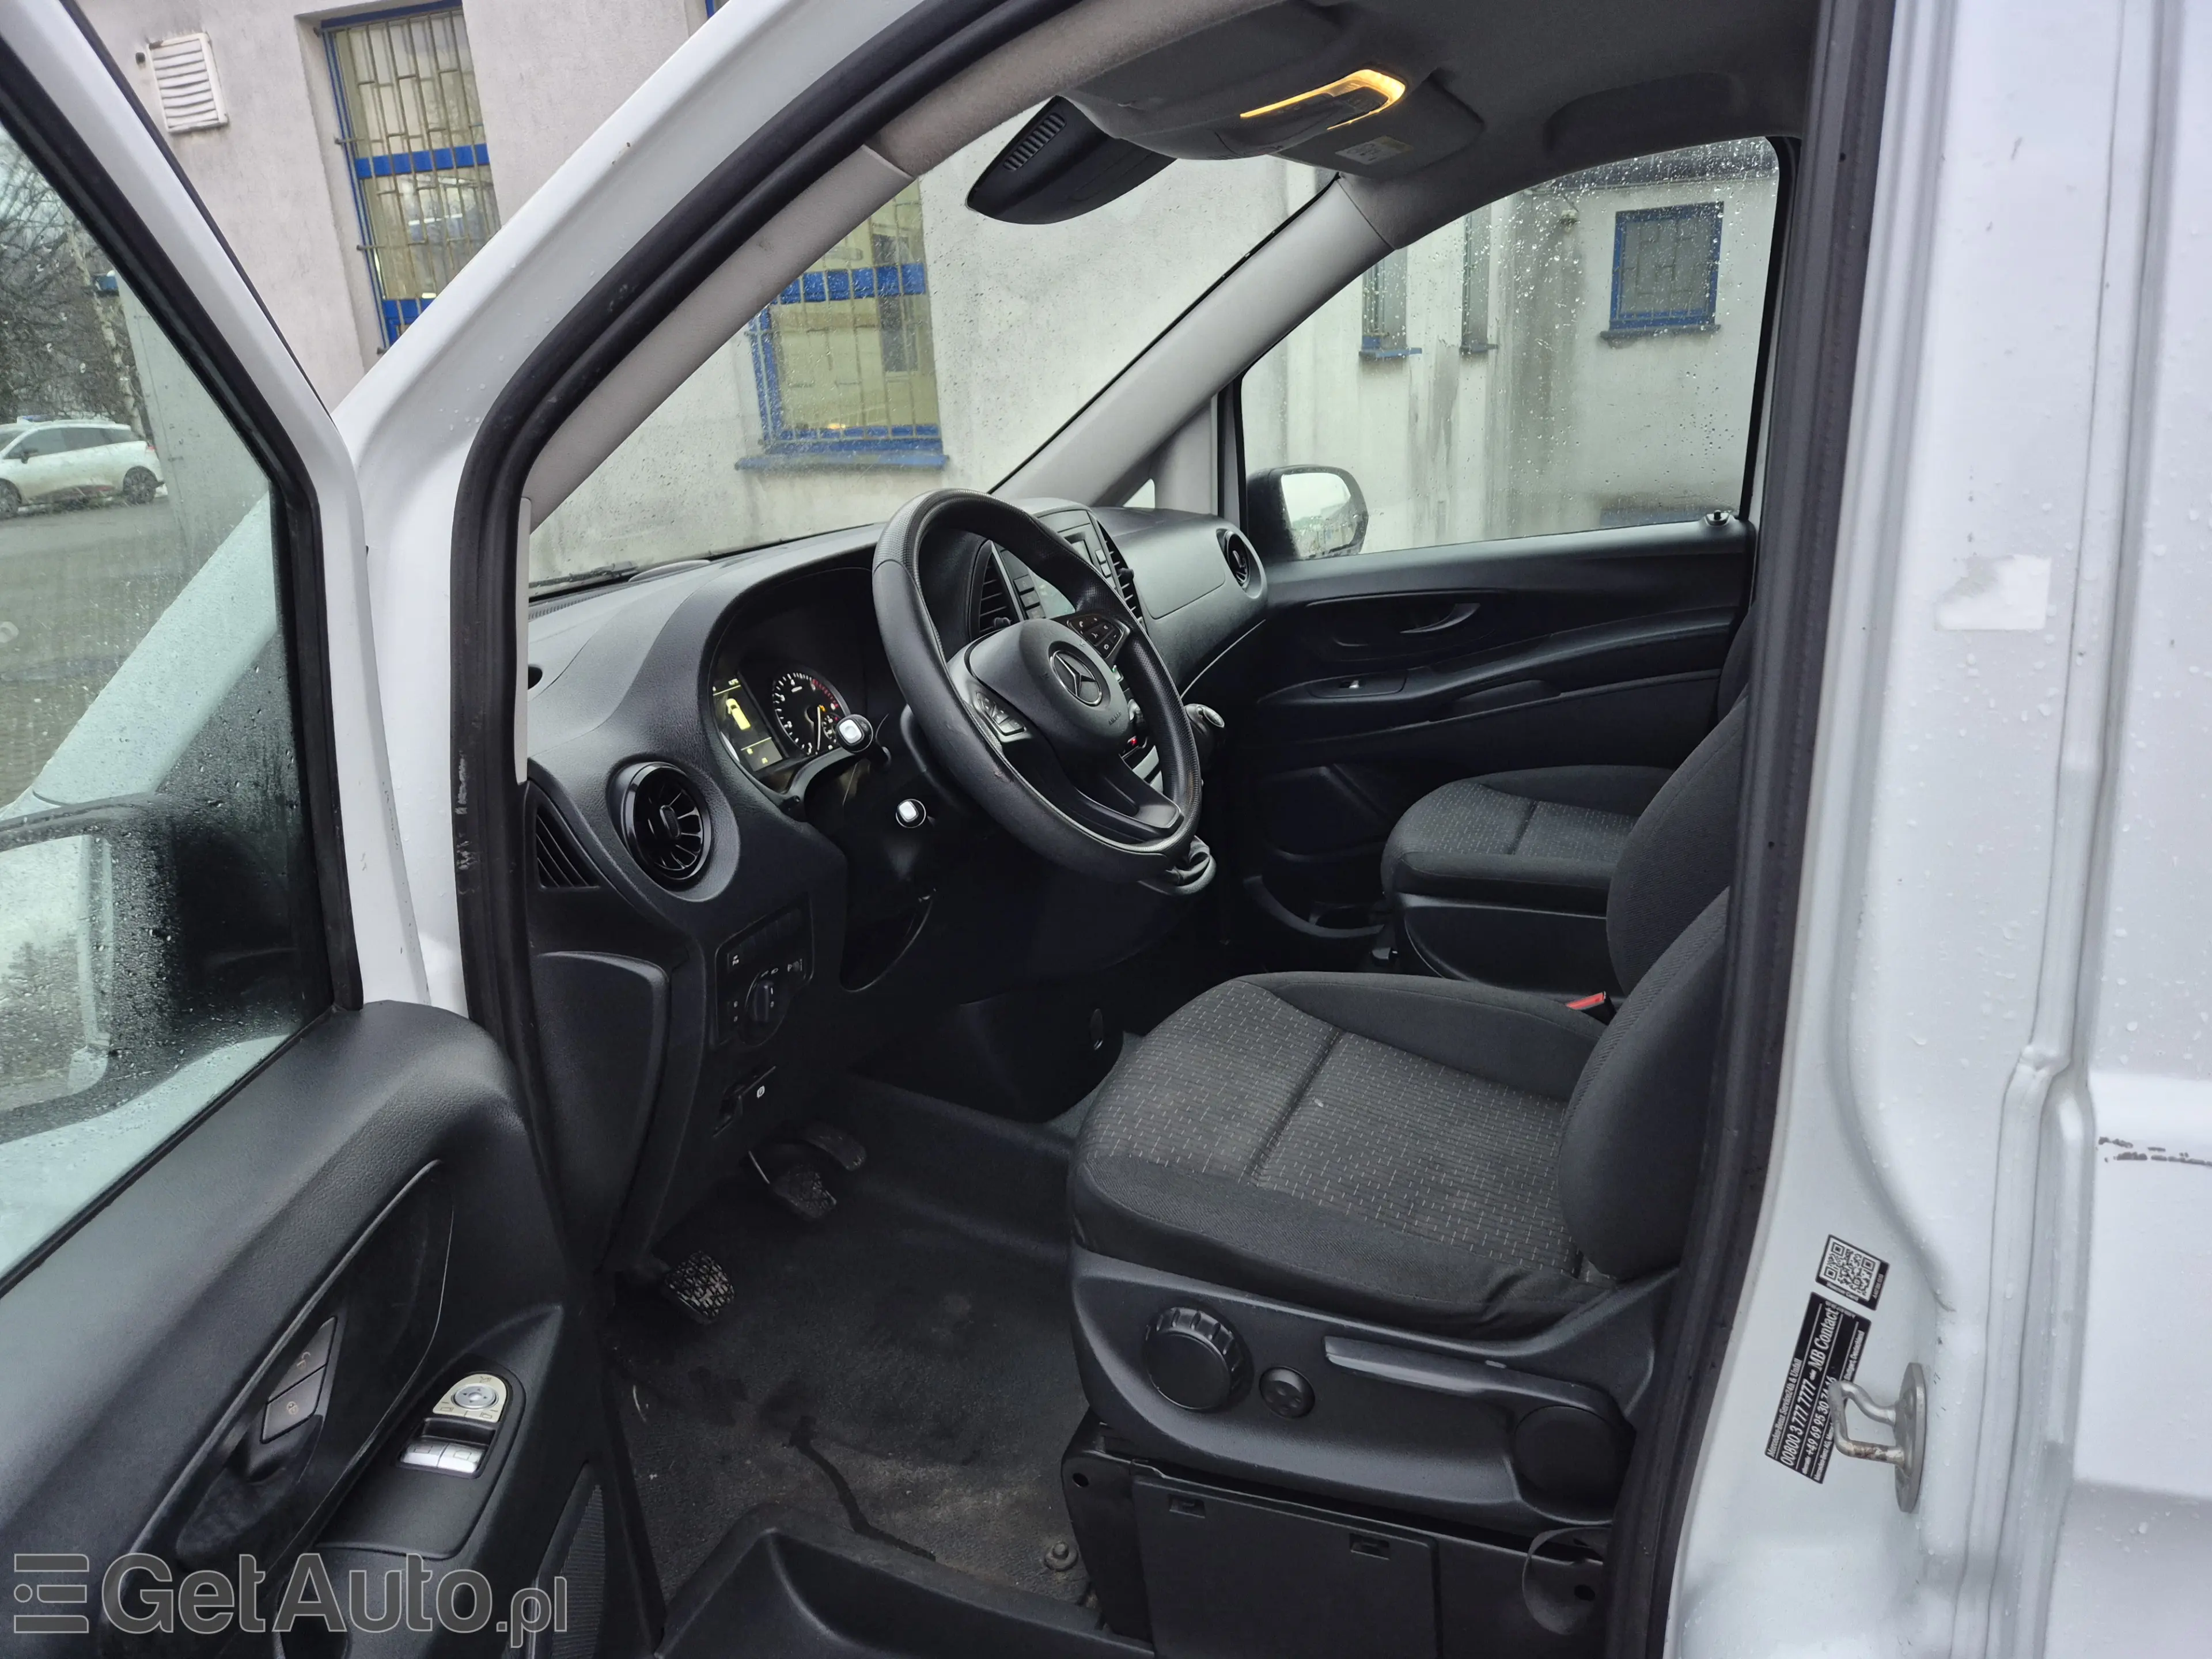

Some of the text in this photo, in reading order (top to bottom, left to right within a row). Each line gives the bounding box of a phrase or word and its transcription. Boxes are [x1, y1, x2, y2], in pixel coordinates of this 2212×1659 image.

[1814, 1308, 1839, 1350] Contact
[1808, 1349, 1825, 1372] MB
[1797, 1378, 1816, 1407] 7777
[1792, 1404, 1809, 1427] 777
[1817, 1400, 1830, 1414] 30
[1789, 1425, 1803, 1435] 3
[1813, 1413, 1825, 1426] 95
[1767, 1415, 1785, 1457] Mercedes-Benz
[1810, 1426, 1821, 1439] 69
[1781, 1434, 1800, 1465] 00800
[1806, 1438, 1817, 1456] +49
